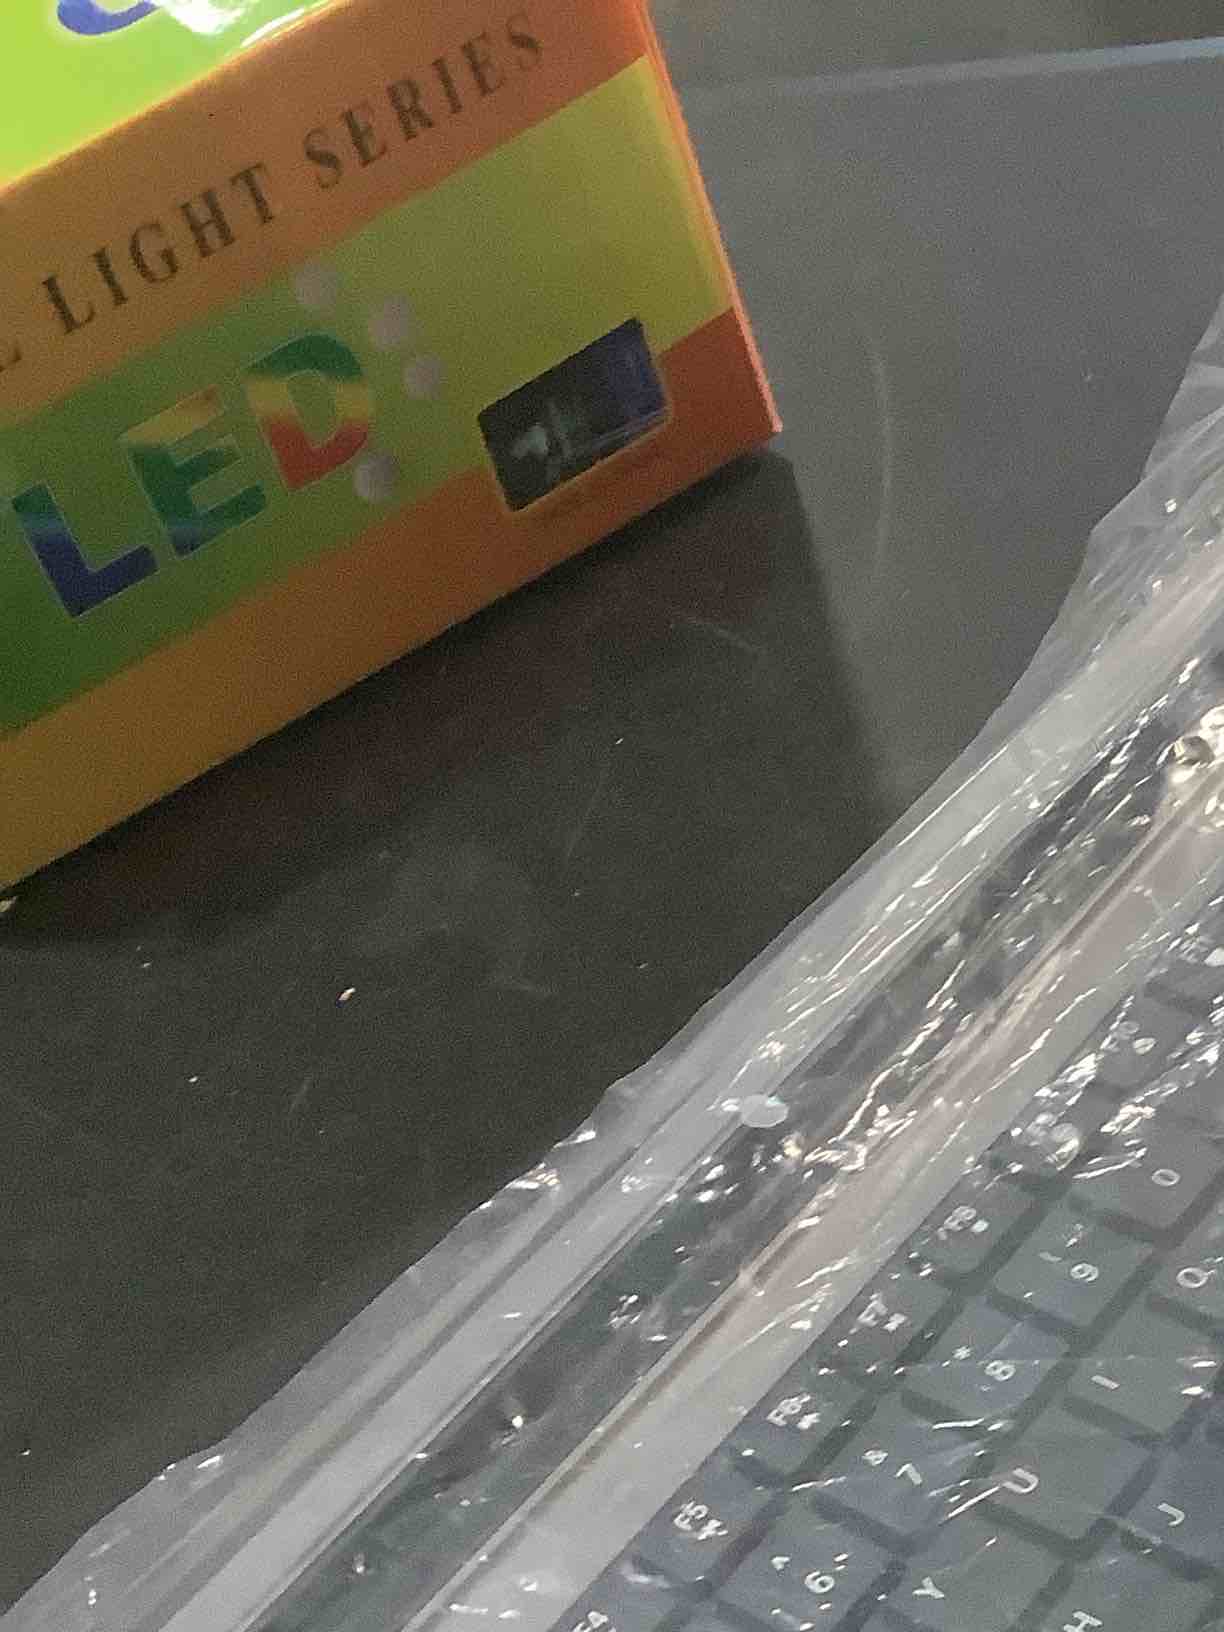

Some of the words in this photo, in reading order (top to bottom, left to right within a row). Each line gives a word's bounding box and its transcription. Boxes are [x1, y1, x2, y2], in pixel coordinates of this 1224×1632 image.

[41, 162, 276, 335] LIGHT
[303, 13, 545, 190] SERIES
[13, 332, 371, 618] LED
[1070, 1263, 1100, 1283] 9
[985, 1361, 1016, 1381] 8
[896, 1463, 923, 1485] 7
[1003, 1468, 1040, 1493] U
[804, 1571, 836, 1594] 6
[913, 1577, 945, 1599] Y
